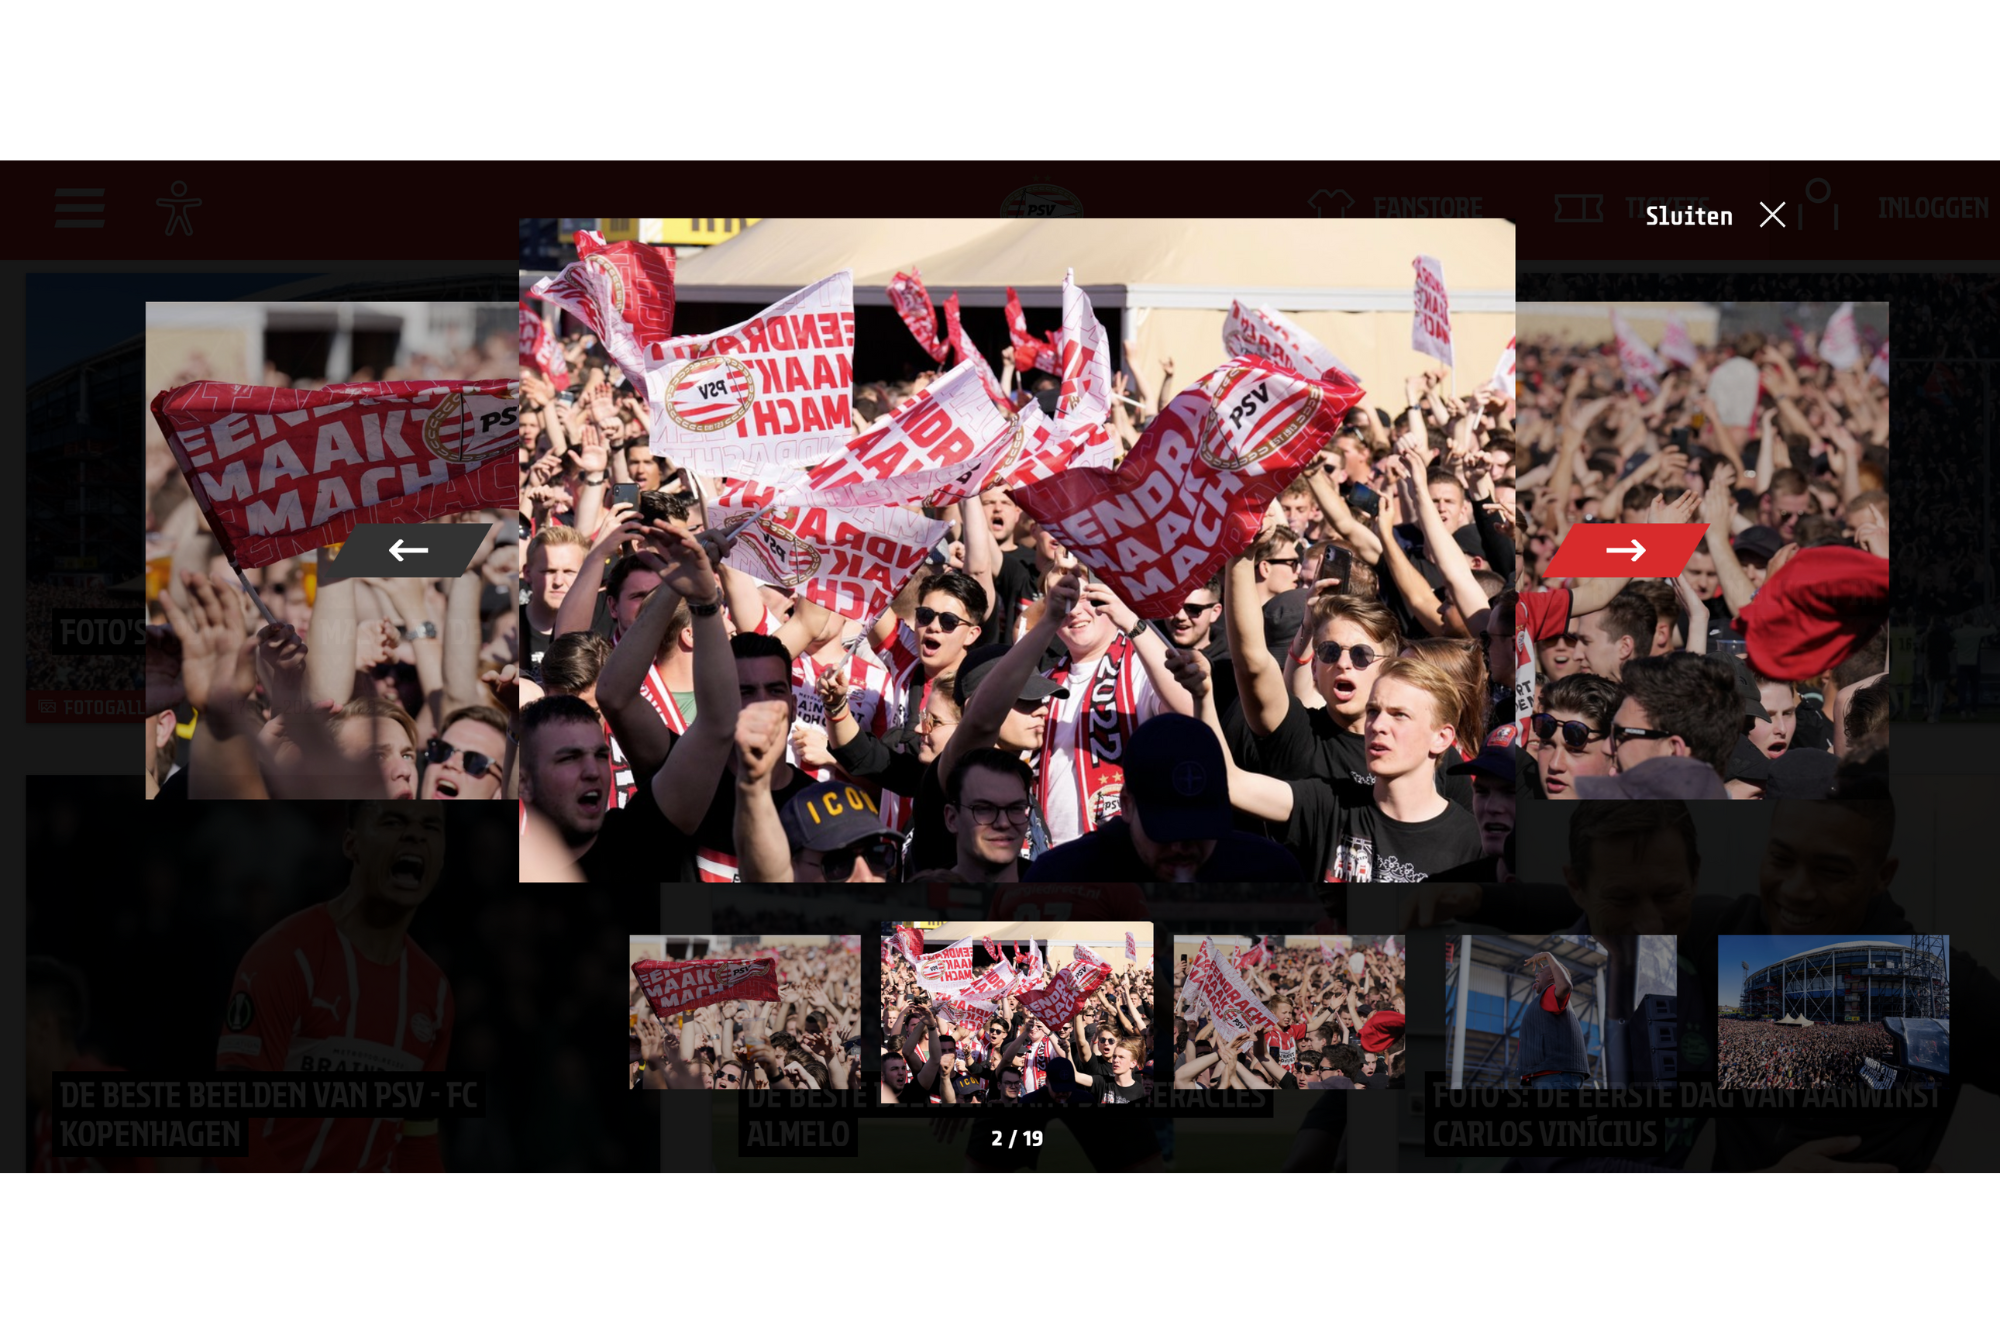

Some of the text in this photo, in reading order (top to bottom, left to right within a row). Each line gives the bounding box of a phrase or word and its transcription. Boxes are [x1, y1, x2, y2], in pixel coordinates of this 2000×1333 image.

[1373, 197, 1483, 218] FANSTORE
[1646, 205, 1733, 226] Sluiten
[1878, 197, 1989, 218] INLOGGEN
[1229, 382, 1270, 430] PSV
[1088, 655, 1124, 769] 2022
[61, 1082, 95, 1107] DE
[102, 1082, 181, 1107] BESTE
[188, 1082, 306, 1107] BEELDEN
[313, 1082, 366, 1107] VAN
[375, 1082, 425, 1107] PSV
[447, 1082, 478, 1107] FC
[1537, 1082, 1570, 1107] DE
[1578, 1082, 1674, 1107] EERSTE
[1679, 1082, 1735, 1107] DAG
[1742, 1082, 1796, 1107] VAN
[1801, 1082, 1943, 1107] AANWINST
[61, 1121, 240, 1146] KOPENHAGEN
[746, 1120, 850, 1146] ALMELO
[991, 1130, 1003, 1147] 2
[1023, 1130, 1044, 1147] 19
[1433, 1120, 1534, 1146] CARLOS
[1538, 1114, 1658, 1146] VINÍCIUS
